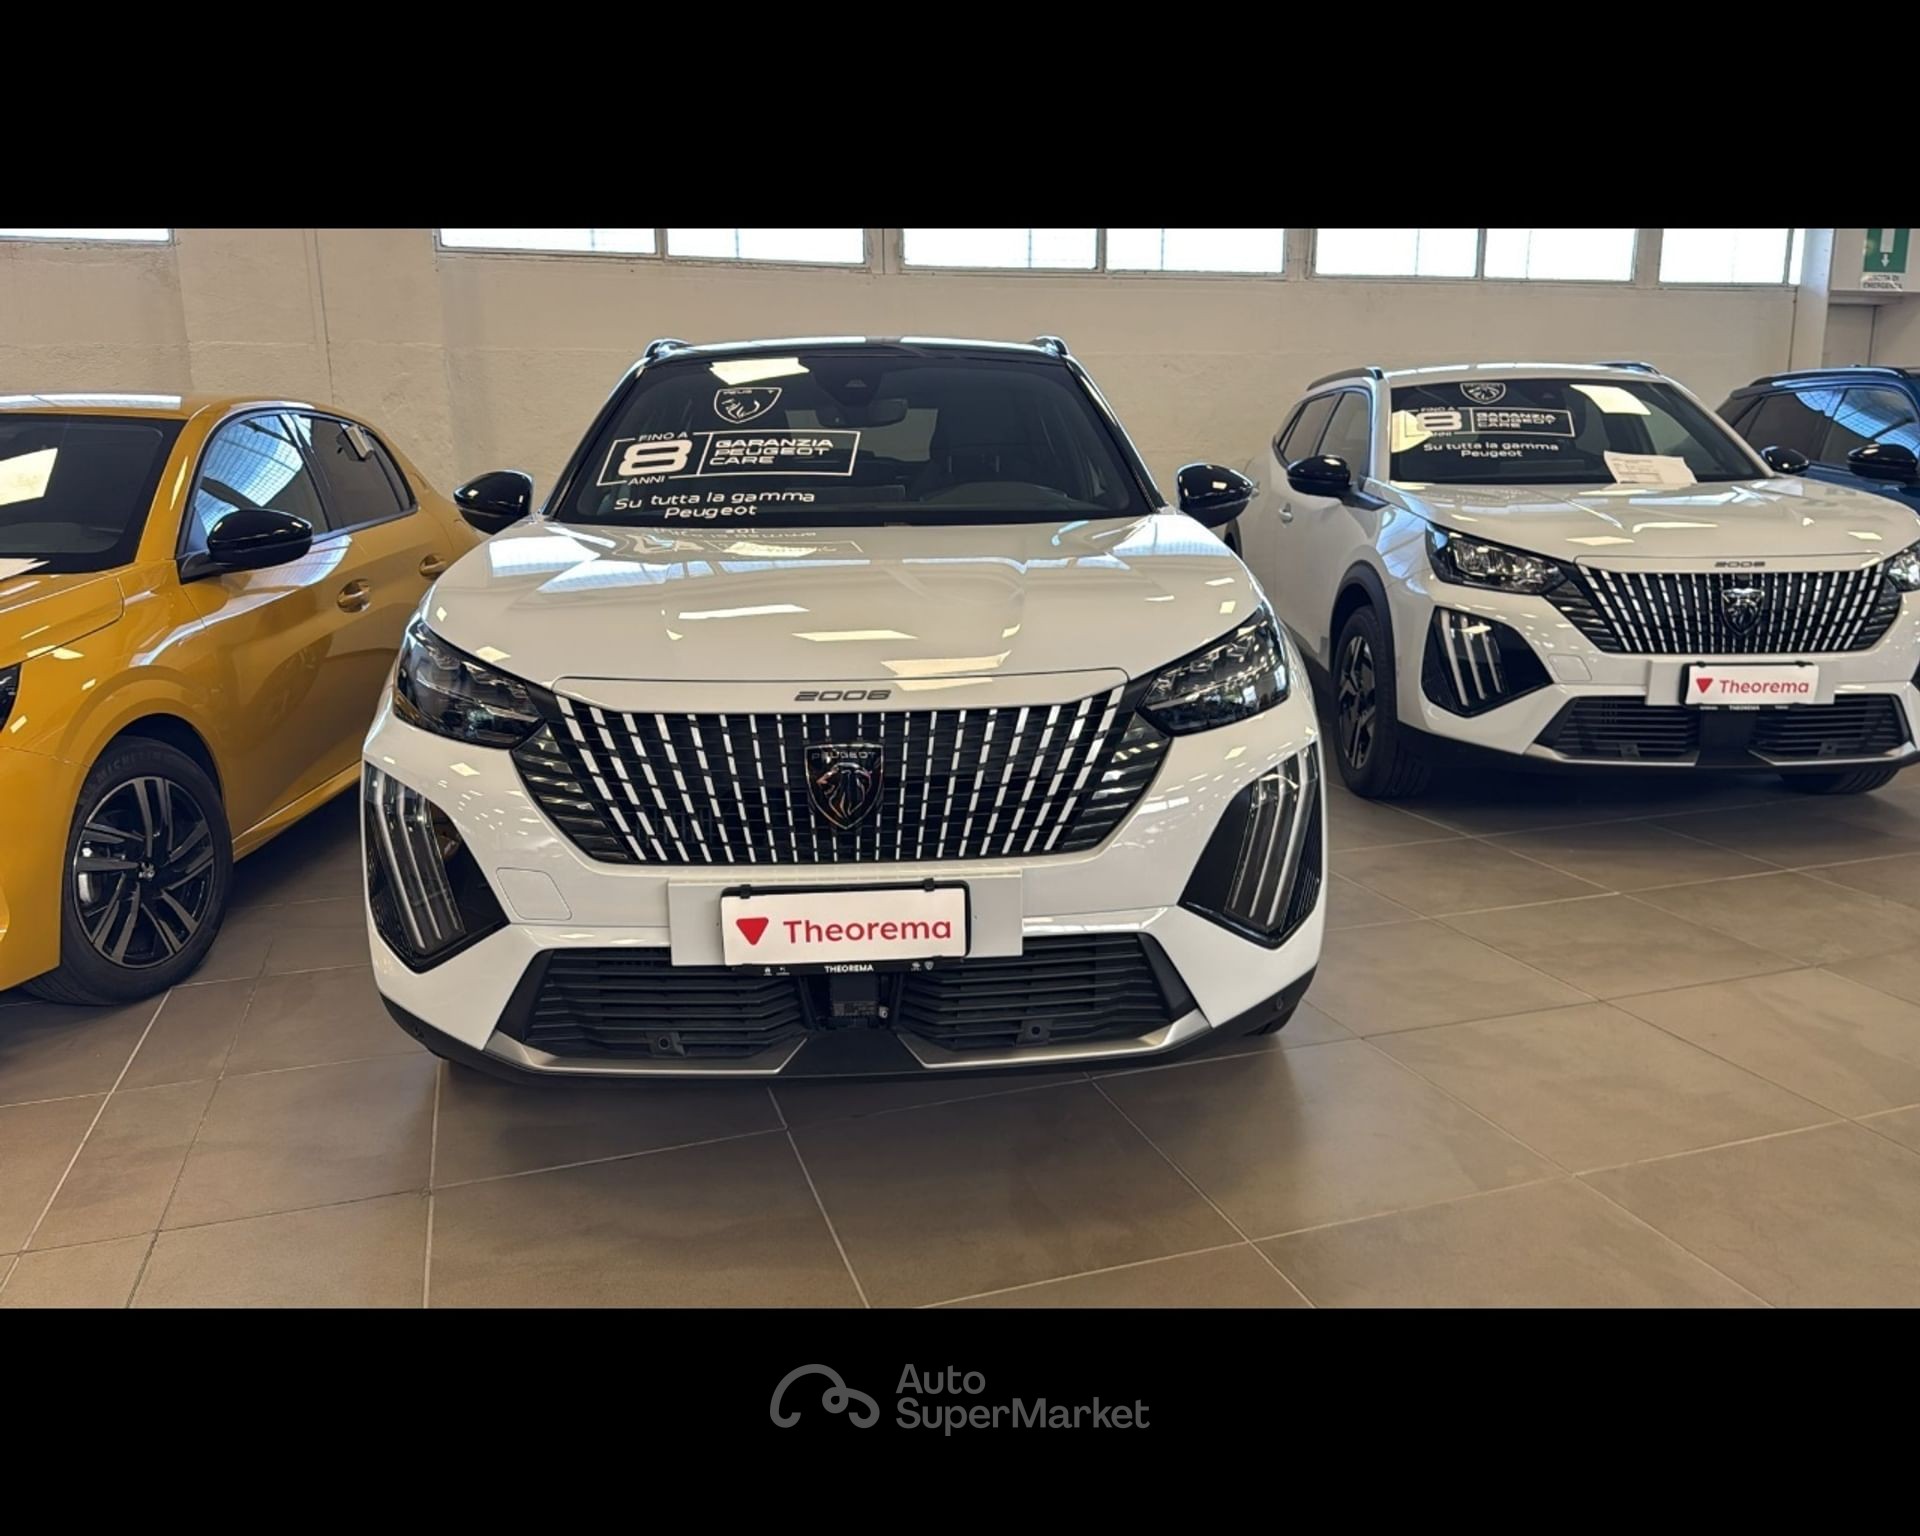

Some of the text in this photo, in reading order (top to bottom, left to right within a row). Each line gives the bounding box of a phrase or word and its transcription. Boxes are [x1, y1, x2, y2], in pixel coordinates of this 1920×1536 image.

[1416, 411, 1463, 432] 8
[638, 431, 689, 442] FINO A
[715, 439, 834, 448] GARANZIA
[1423, 441, 1559, 451] Su tutta la gamma
[714, 447, 830, 456] PEUGEOT
[1461, 449, 1523, 458] Peugeot
[618, 440, 693, 476] 8
[709, 456, 776, 465] CARE
[627, 475, 666, 486] ANNI
[614, 491, 815, 511] Su tutta la gamma
[664, 505, 757, 519] Peugeot
[1720, 680, 1809, 694] Theorema
[783, 919, 951, 944] Theorema
[824, 964, 874, 974] THEOREMA
